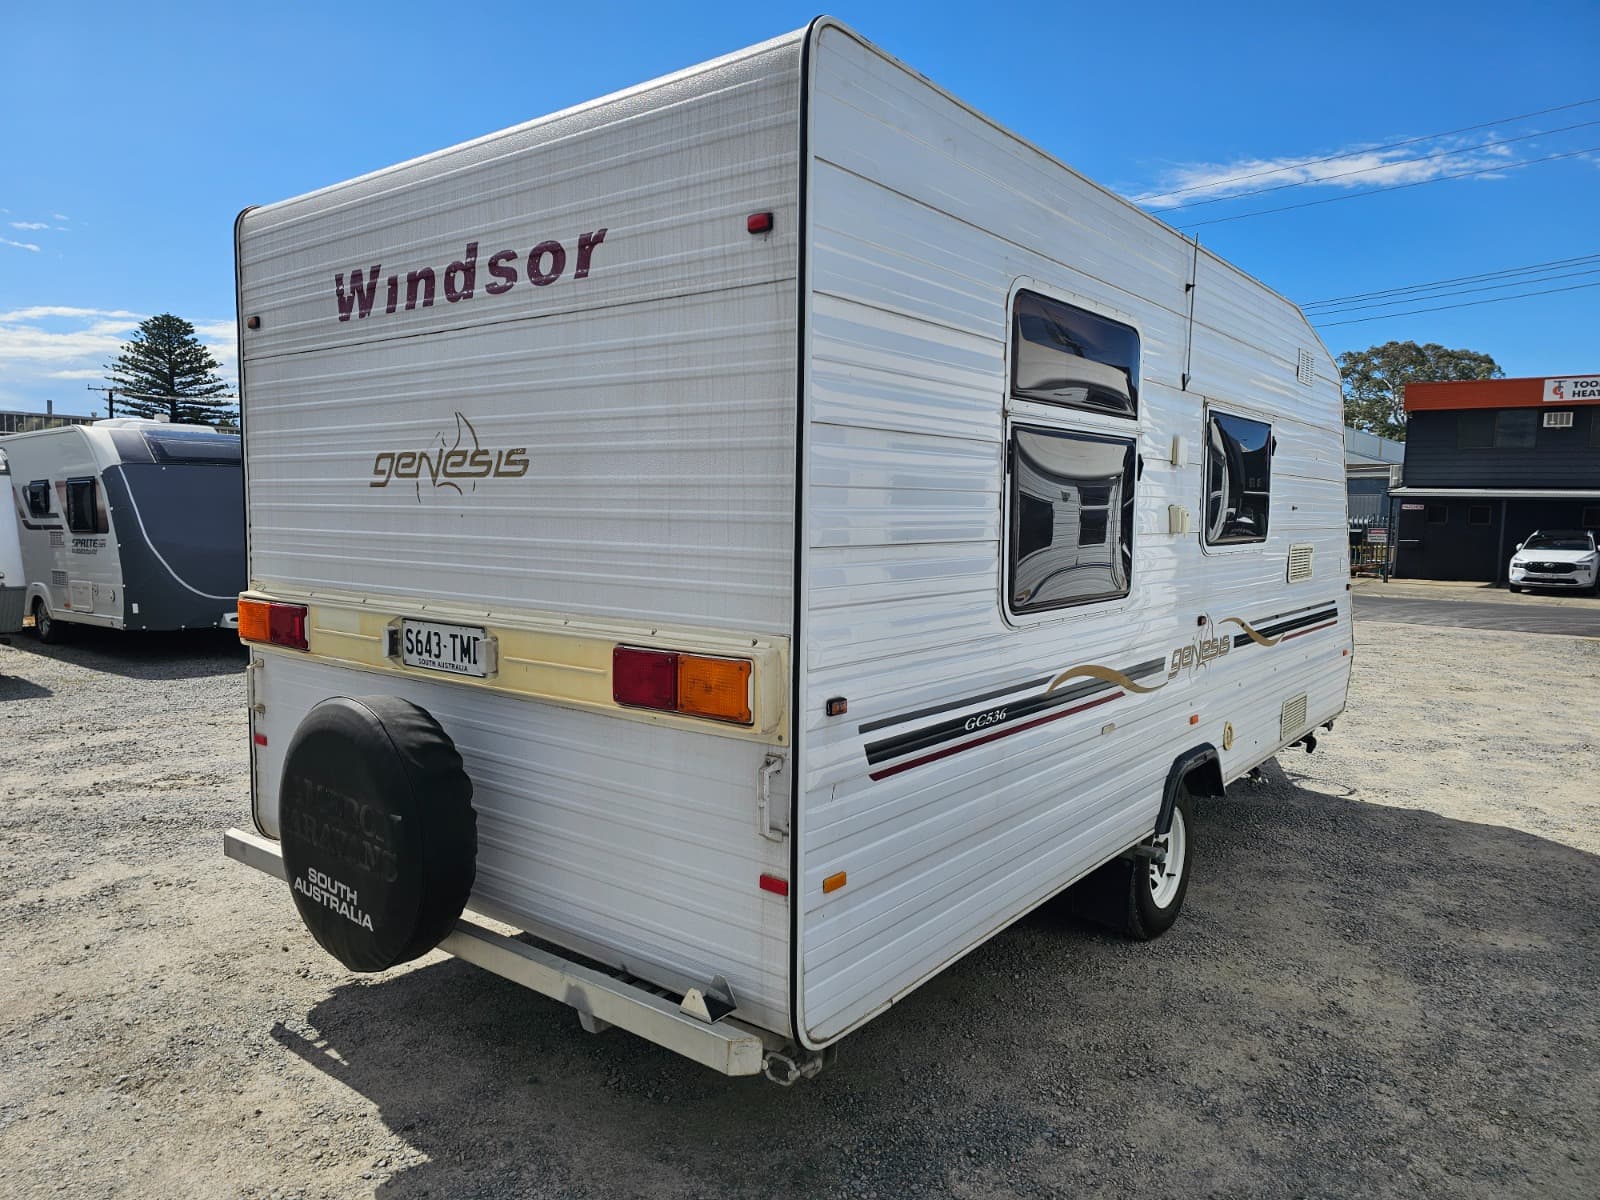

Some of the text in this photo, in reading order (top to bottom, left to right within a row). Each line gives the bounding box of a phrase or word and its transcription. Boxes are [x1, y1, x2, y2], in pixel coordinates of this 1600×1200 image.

[334, 228, 608, 322] Windsor
[1573, 380, 1600, 389] TOO
[418, 657, 468, 673] SOUTH AUSTRALIA
[964, 707, 1008, 731] GC536
[308, 867, 357, 906] SOUTH
[293, 876, 374, 932] AUSTRALIA
